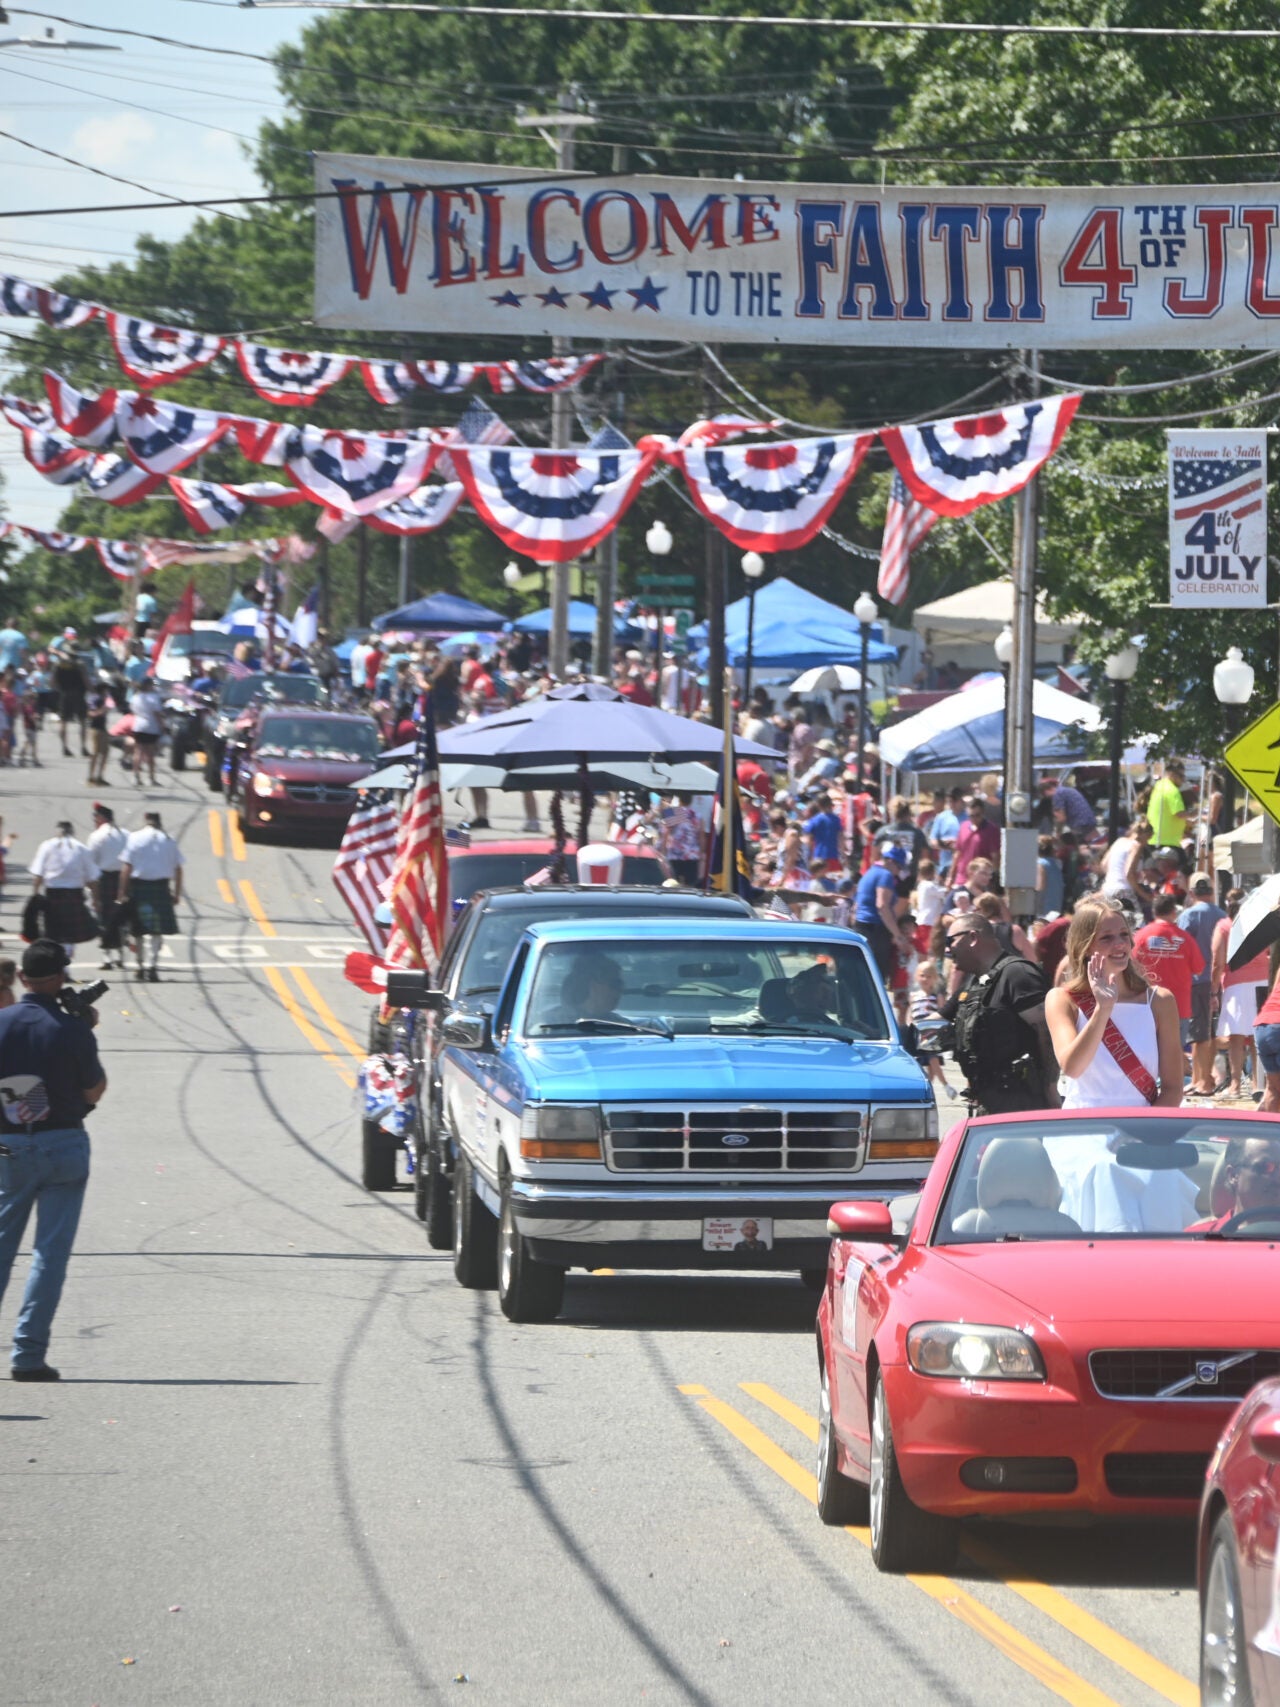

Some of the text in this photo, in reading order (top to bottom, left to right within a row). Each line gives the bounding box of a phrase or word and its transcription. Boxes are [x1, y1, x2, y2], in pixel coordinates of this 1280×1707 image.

[330, 177, 782, 301] WELCOME
[1139, 238, 1187, 268] OF
[795, 198, 1047, 322] FAITH
[687, 270, 783, 318] TO THE
[1173, 444, 1262, 459] Welcome to Faith
[1222, 522, 1242, 556] of
[1174, 555, 1263, 581] JULY
[1176, 582, 1260, 594] CELEBRATION
